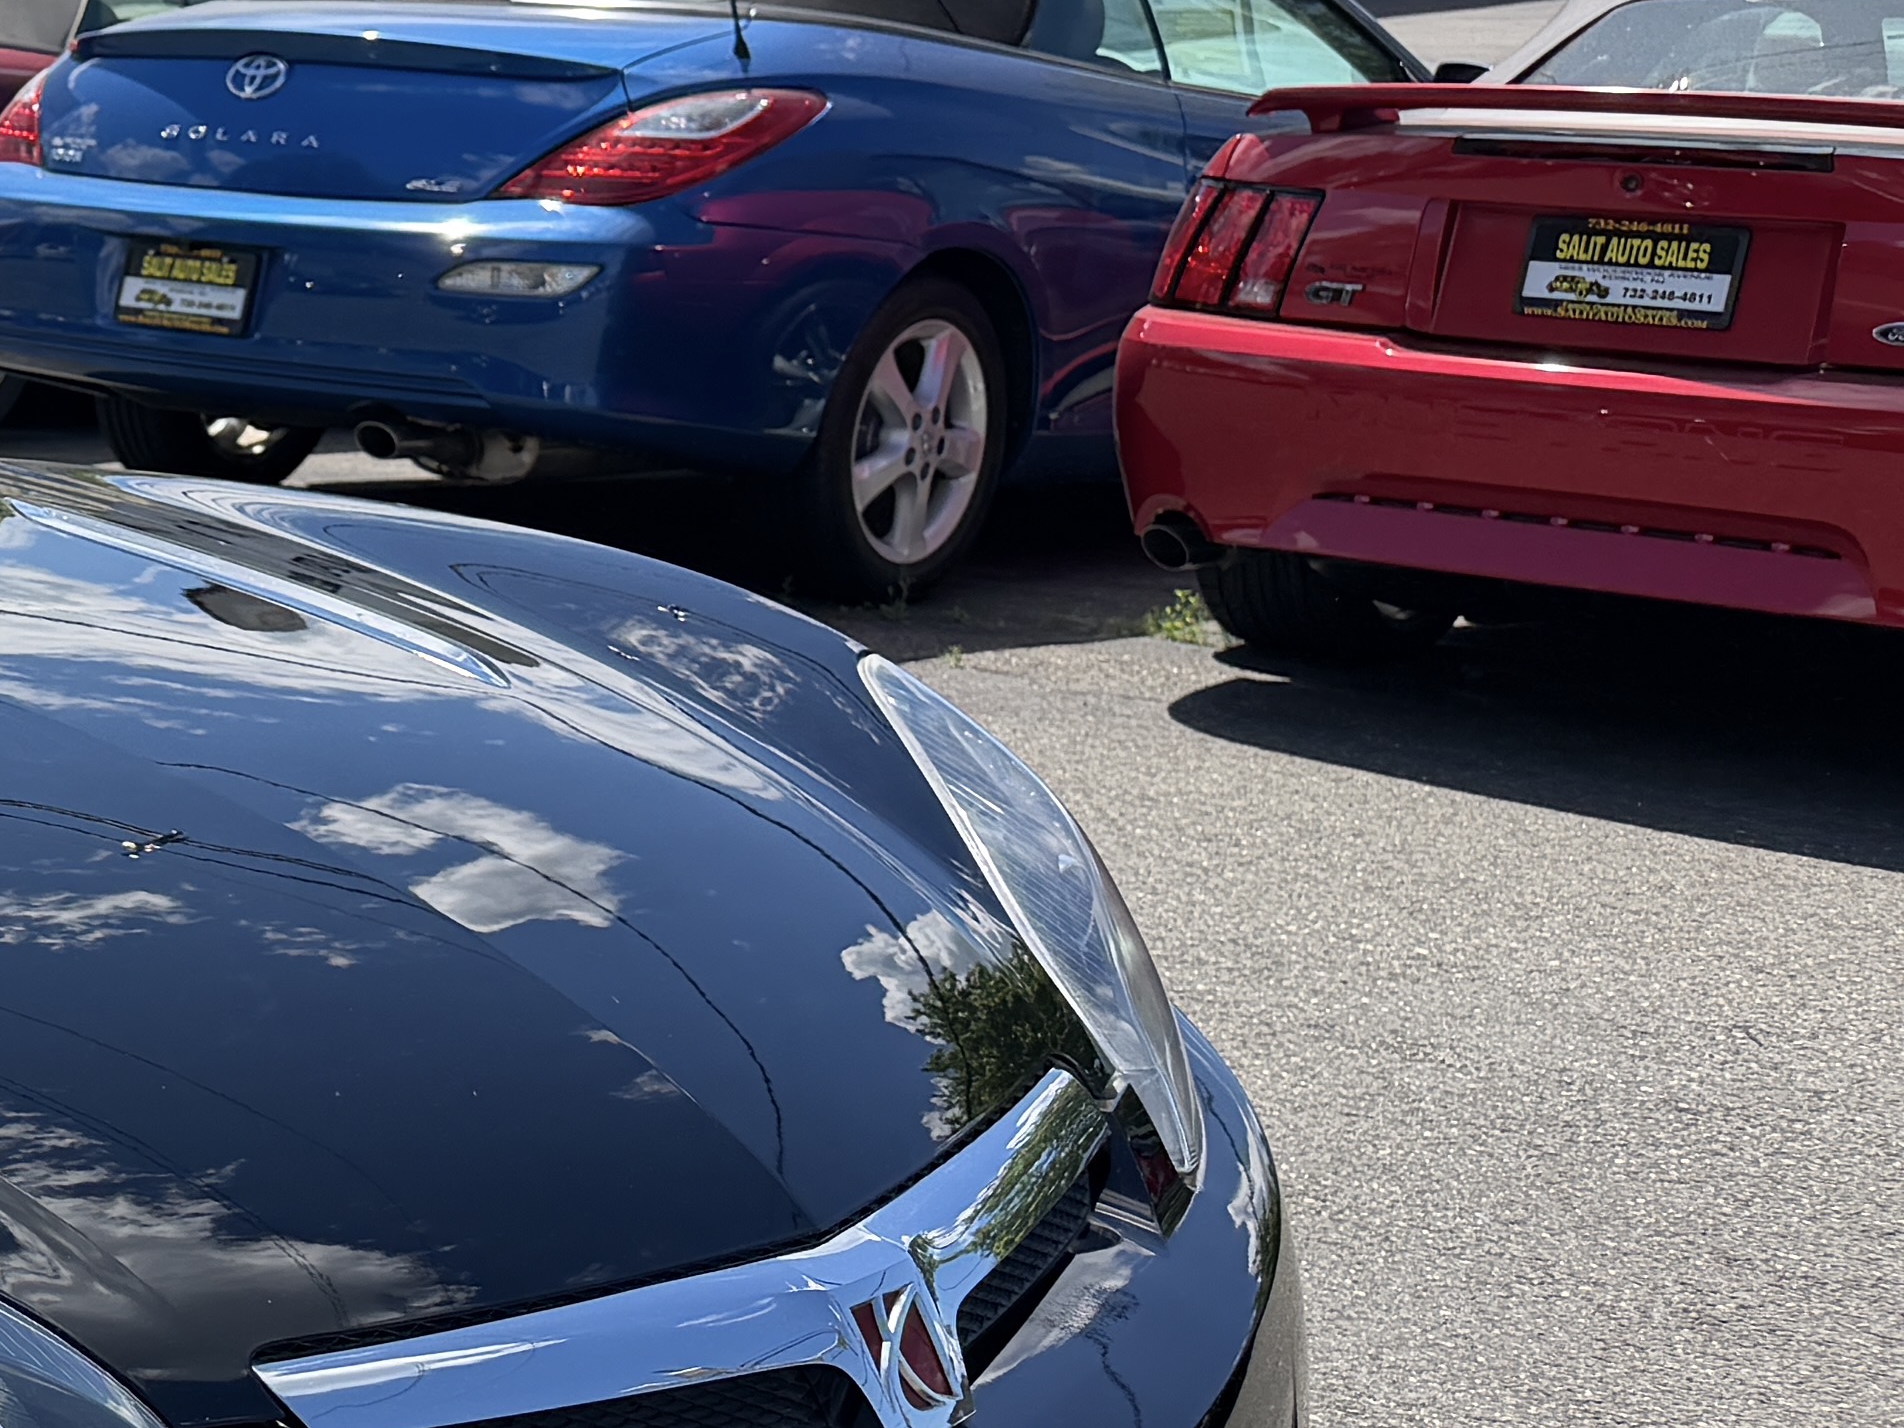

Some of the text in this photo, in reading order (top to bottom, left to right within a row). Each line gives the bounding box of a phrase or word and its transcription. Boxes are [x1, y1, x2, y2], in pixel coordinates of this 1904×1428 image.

[159, 123, 320, 149] SOLARA
[1555, 233, 1712, 270] SALIT AUTO SALES
[1304, 280, 1365, 307] GT
